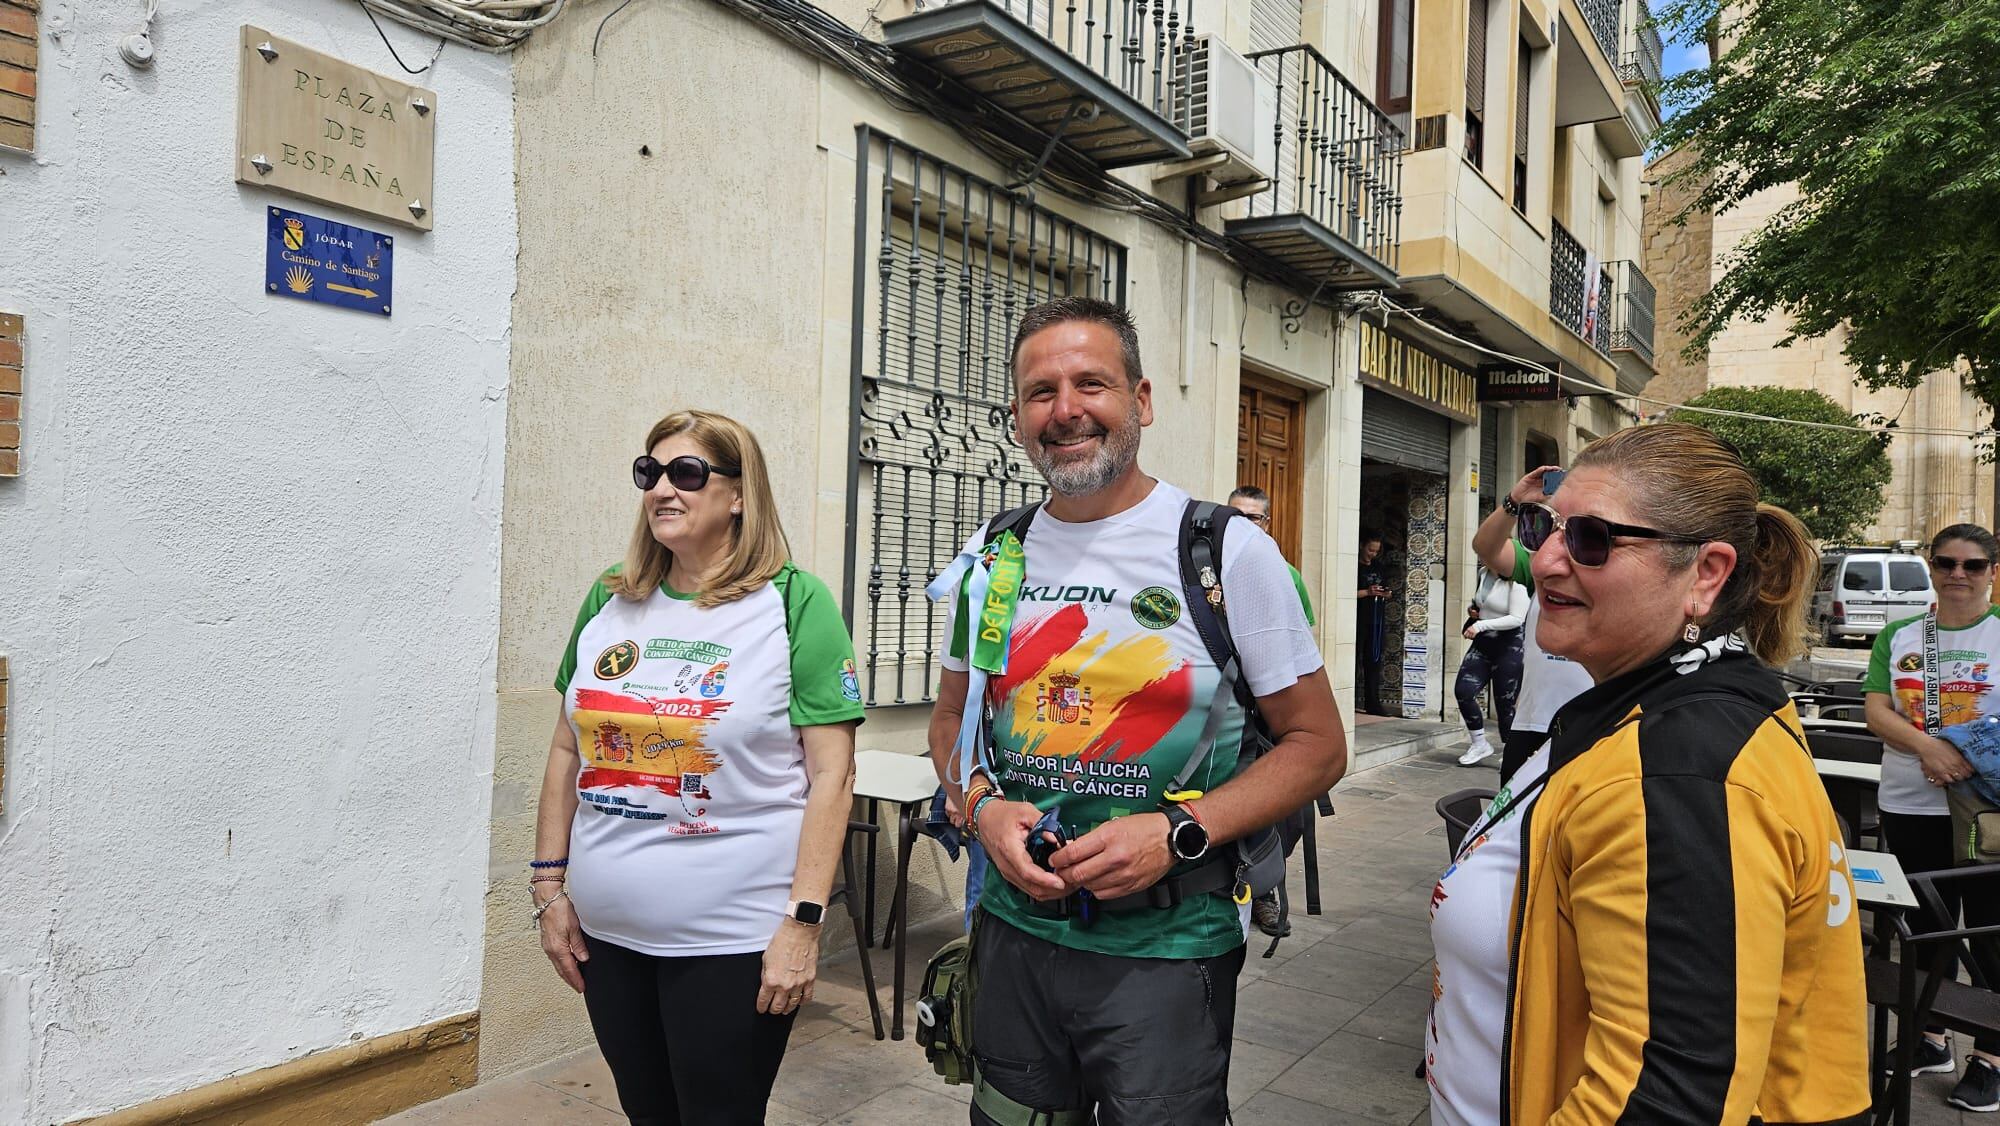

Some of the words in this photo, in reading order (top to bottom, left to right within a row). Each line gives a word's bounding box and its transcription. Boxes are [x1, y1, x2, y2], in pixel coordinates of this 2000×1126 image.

[293, 69, 397, 123] PLAZA
[323, 118, 367, 149] DE
[280, 142, 404, 198] ESPAÑA
[315, 233, 354, 249] JÓDAR
[281, 250, 320, 267] Camino
[325, 260, 338, 271] de
[341, 264, 380, 282] Santiago
[1360, 320, 1387, 380] BAR
[1389, 336, 1403, 388] EL
[1405, 345, 1439, 403] NUEVO
[1441, 362, 1478, 418] EUROPA
[1018, 585, 1117, 603] KUON
[656, 640, 678, 648] RETO
[1946, 684, 1976, 692] 2025
[654, 703, 703, 716] 2025
[1003, 749, 1023, 766] RETO
[1026, 755, 1057, 771] POR
[1062, 759, 1084, 774] LA
[1089, 762, 1151, 779] LUCHA
[1050, 777, 1069, 792] EL
[1073, 776, 1148, 798] CÁNCER
